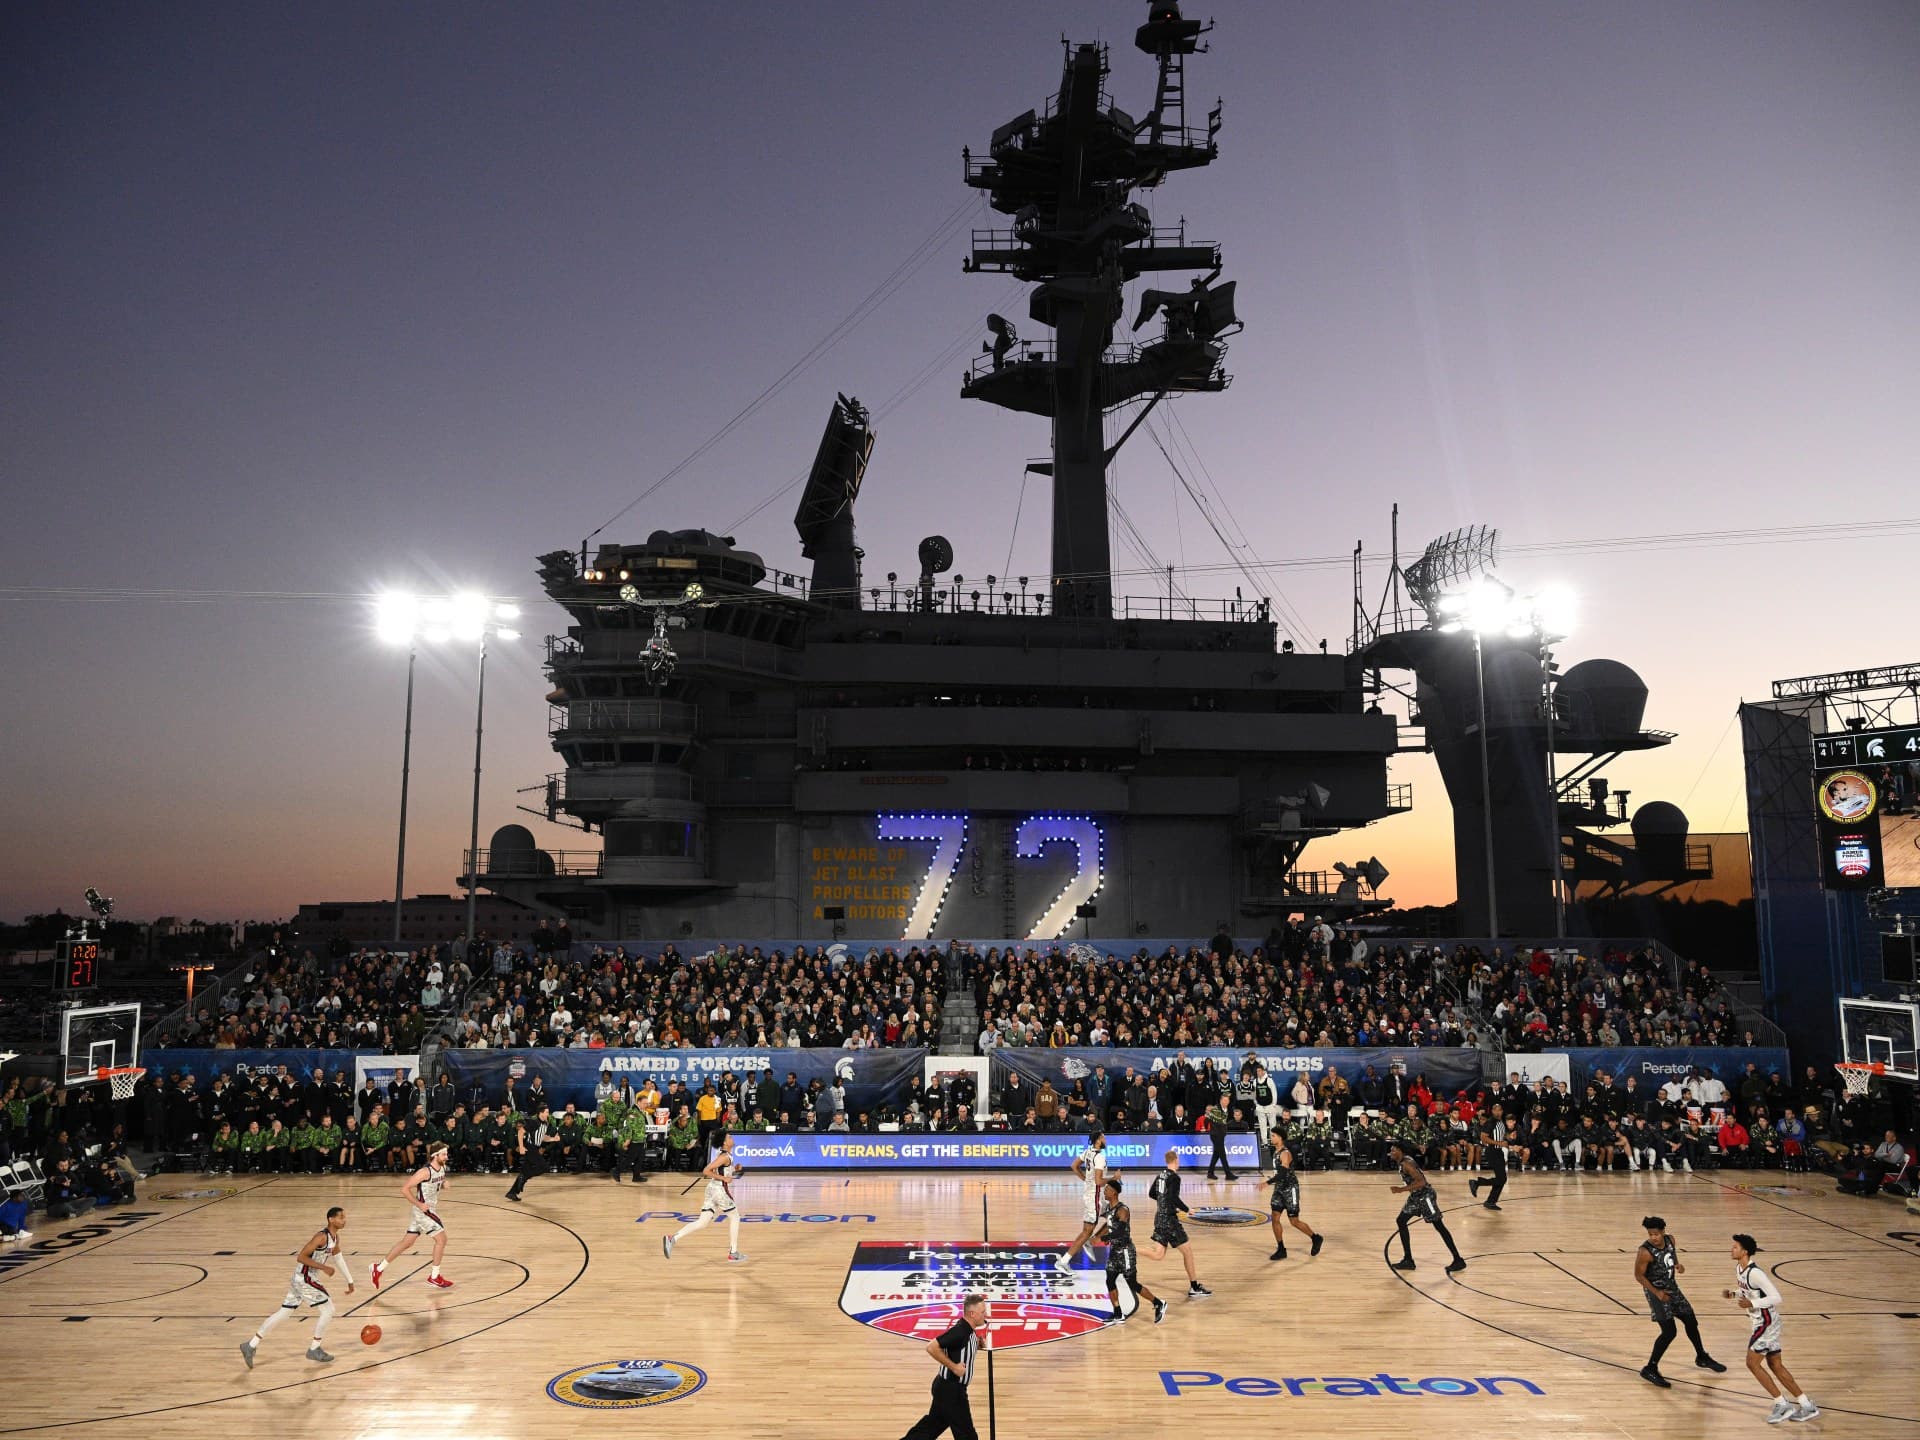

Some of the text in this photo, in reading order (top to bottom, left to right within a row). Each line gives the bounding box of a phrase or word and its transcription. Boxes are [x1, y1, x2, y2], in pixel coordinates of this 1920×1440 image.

[1820, 746, 1847, 757] 4 2
[812, 847, 905, 862] BEWARE OF
[812, 866, 896, 881] JET BLAST
[812, 885, 912, 900] PROPELLERS
[848, 904, 907, 920] ROTORS
[71, 960, 92, 986] 27
[598, 1056, 772, 1072] ARMED FORCES
[820, 1144, 899, 1160] VETERANS,
[901, 1144, 929, 1158] GET
[931, 1144, 960, 1158] THE
[963, 1144, 1030, 1158] BENEFITS
[908, 1250, 1068, 1261] Peraton
[902, 1271, 1074, 1280] ARMED
[901, 1280, 1075, 1288] FORCES
[1158, 1370, 1548, 1397] Peraton
